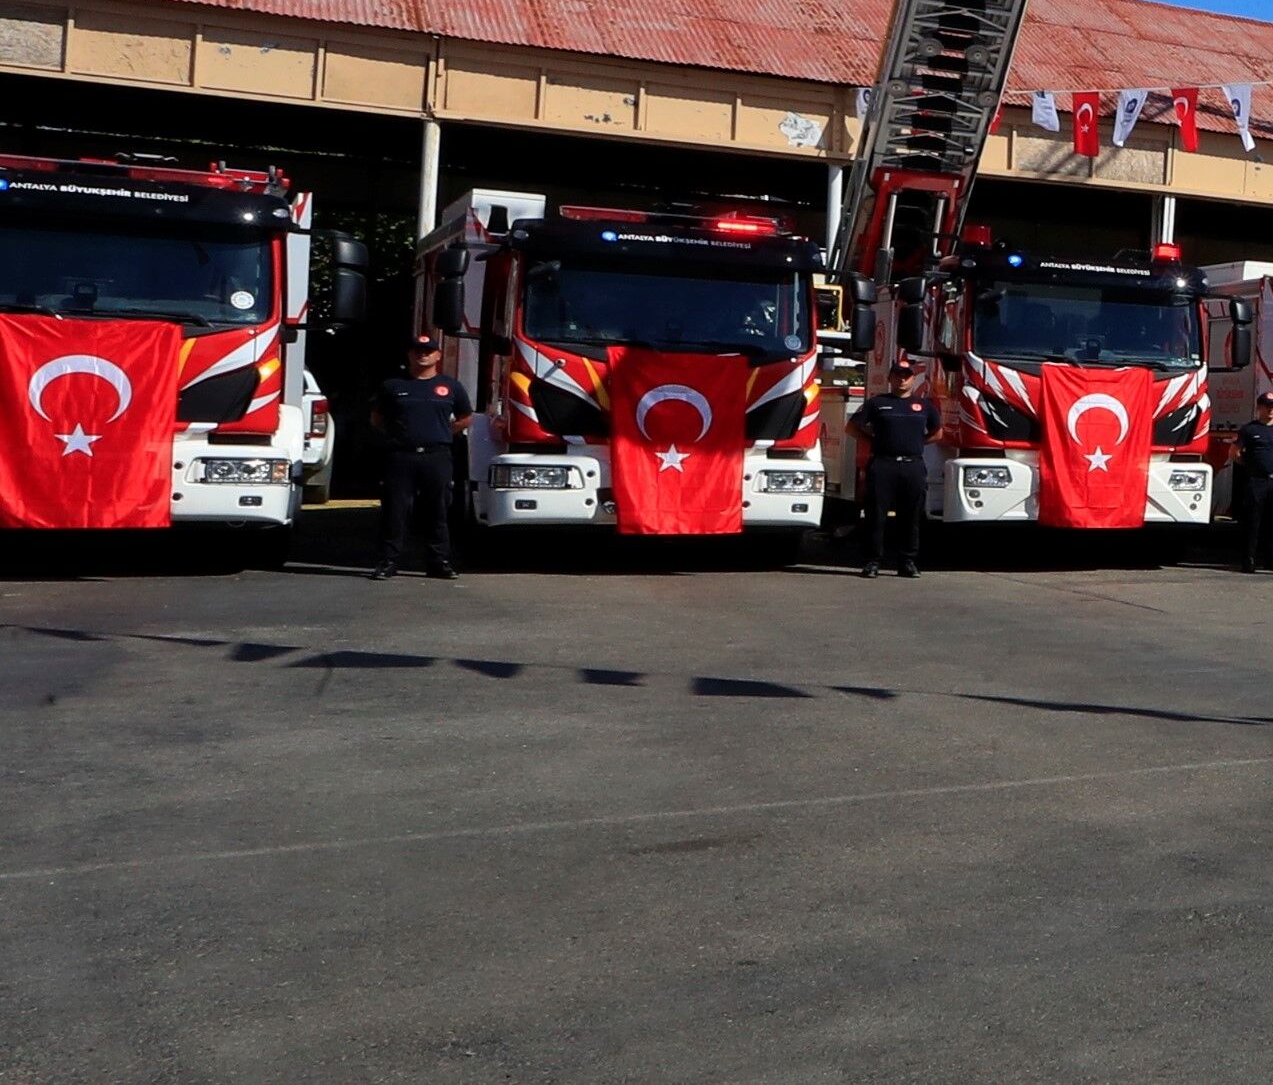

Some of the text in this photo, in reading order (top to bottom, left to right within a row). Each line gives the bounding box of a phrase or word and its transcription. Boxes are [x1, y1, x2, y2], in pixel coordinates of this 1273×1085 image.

[9, 182, 58, 192] ANTALYA
[134, 192, 189, 203] BELEDİYESİ
[618, 234, 751, 250] ANTALYA BÜYÜKŞEHİR BELEDİYESİ
[1040, 262, 1070, 270] ANTALYA
[1071, 263, 1115, 273] BÜYÜKŞEHİR
